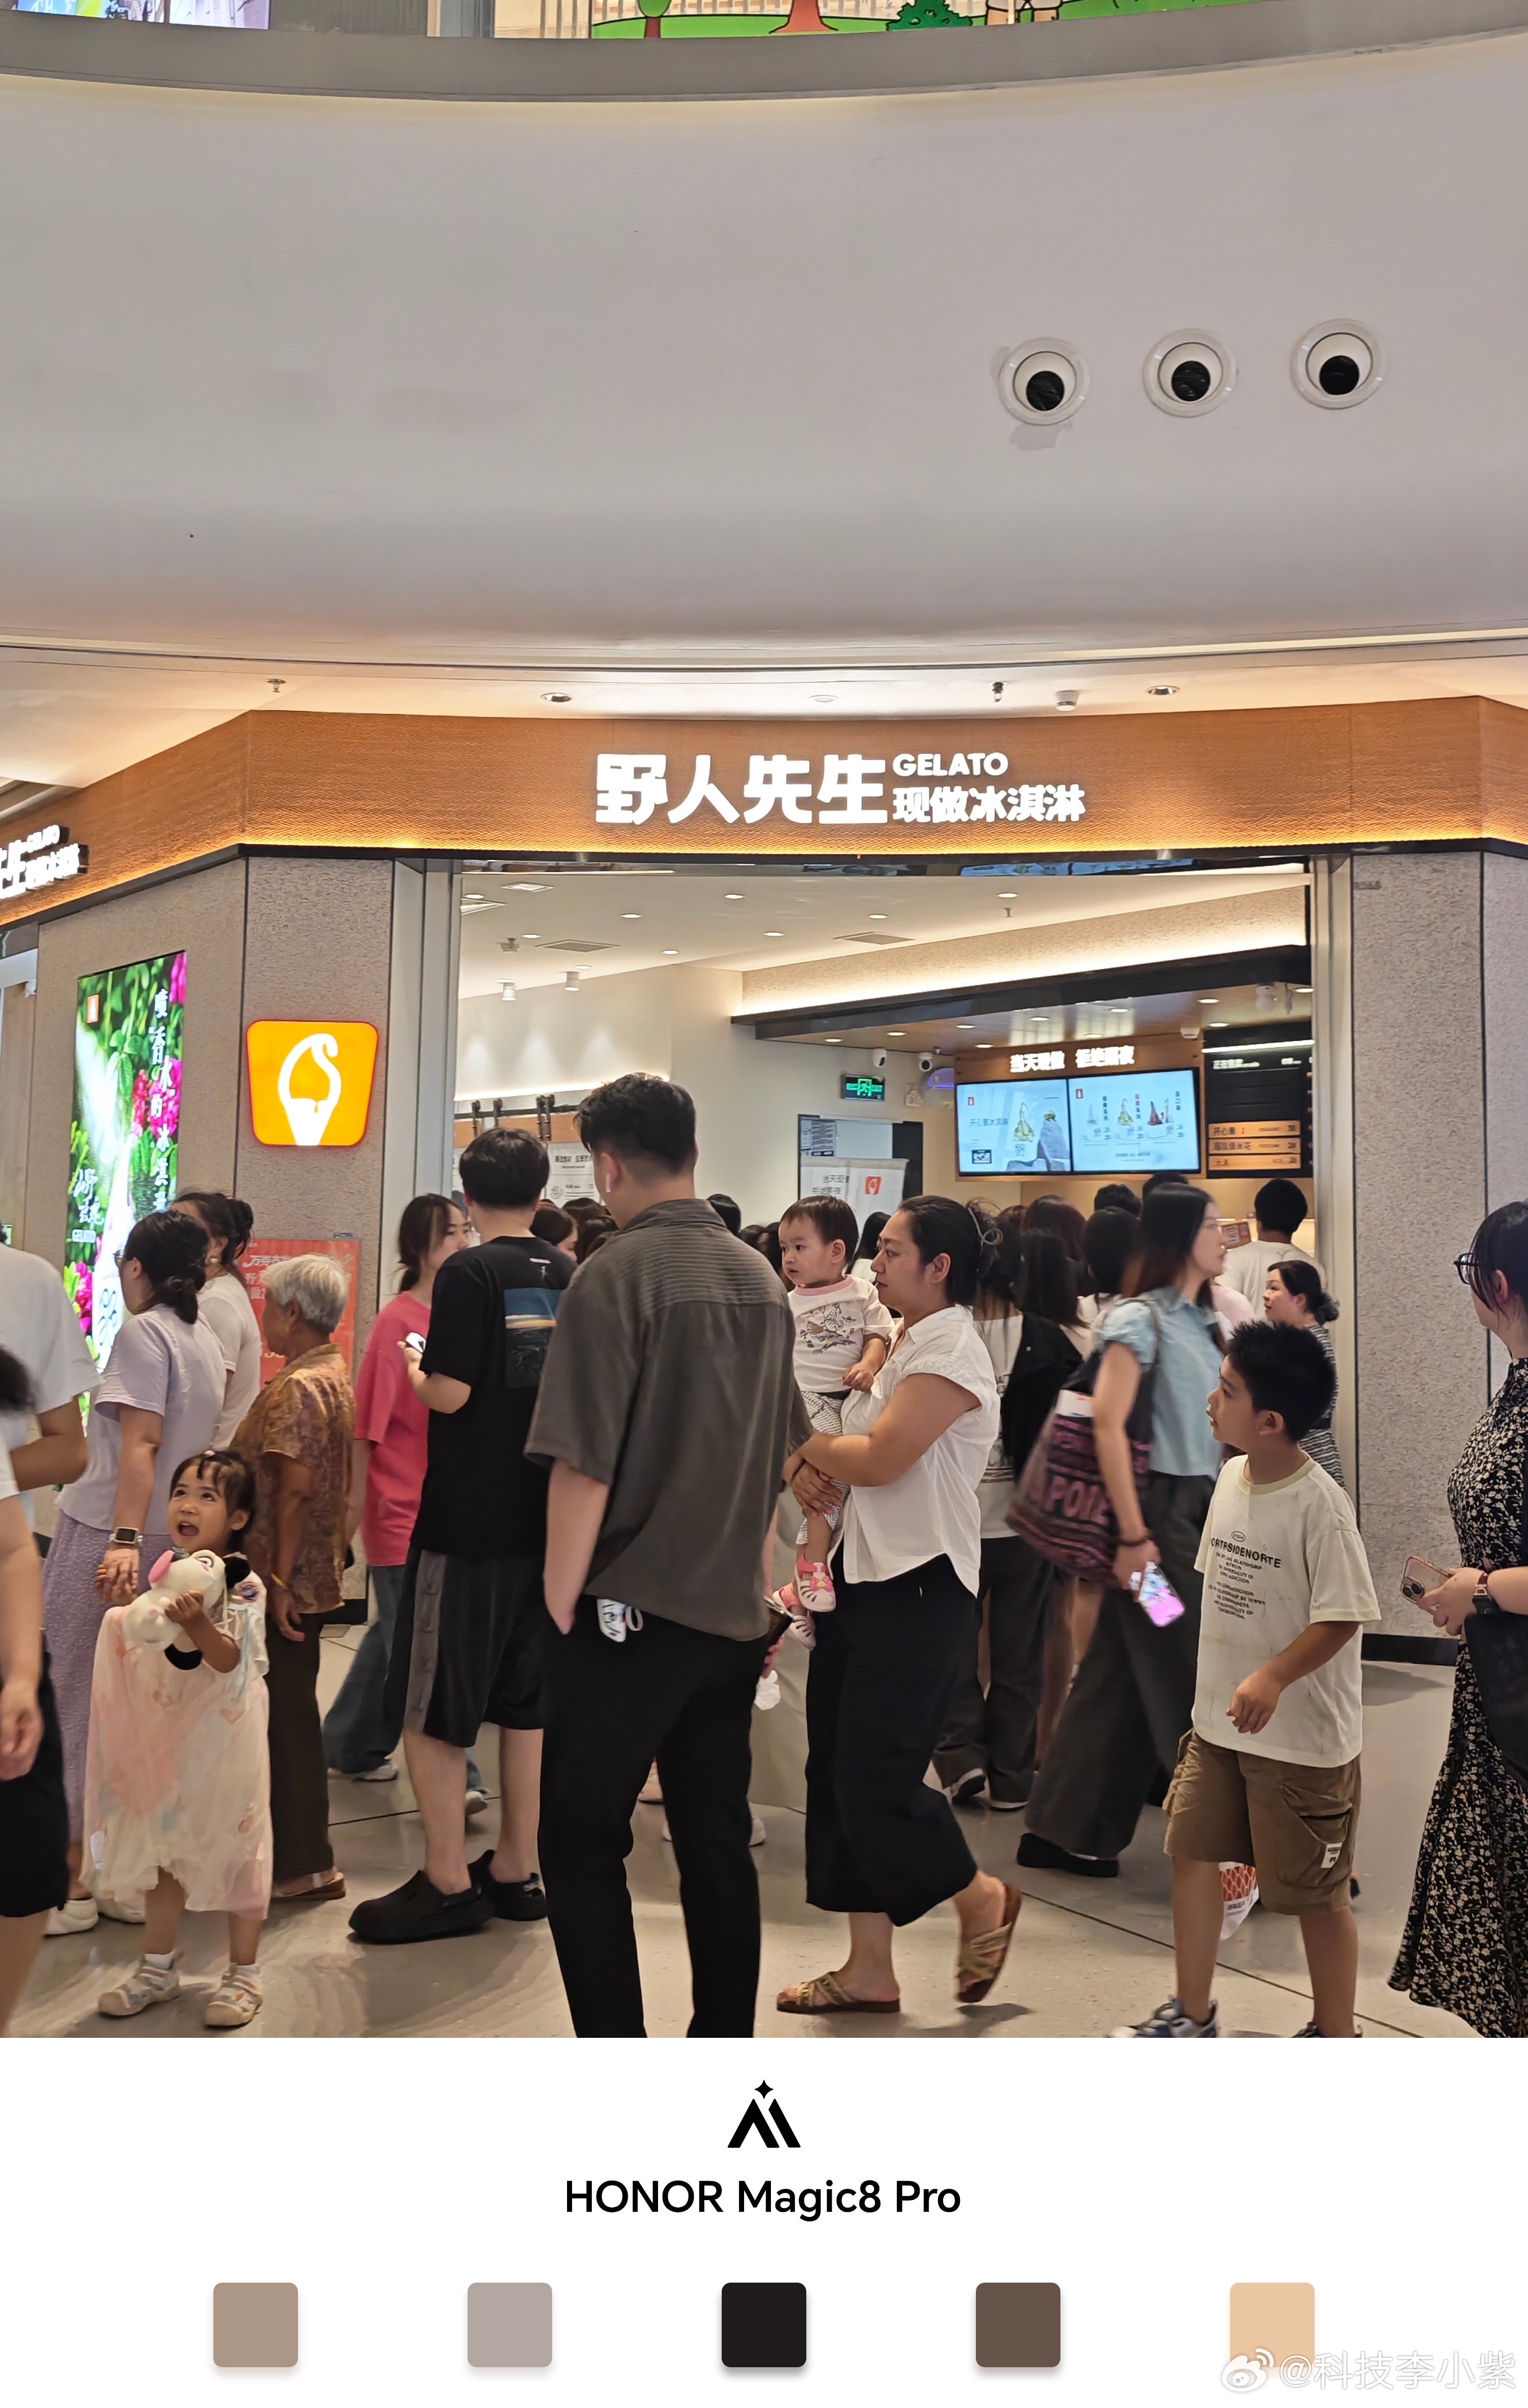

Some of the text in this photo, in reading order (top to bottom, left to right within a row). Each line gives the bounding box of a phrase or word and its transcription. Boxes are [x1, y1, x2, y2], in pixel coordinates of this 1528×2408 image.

[893, 752, 1009, 776] GELATO
[596, 754, 888, 824] 野人先生
[893, 784, 1085, 823] 现做冰淇淋
